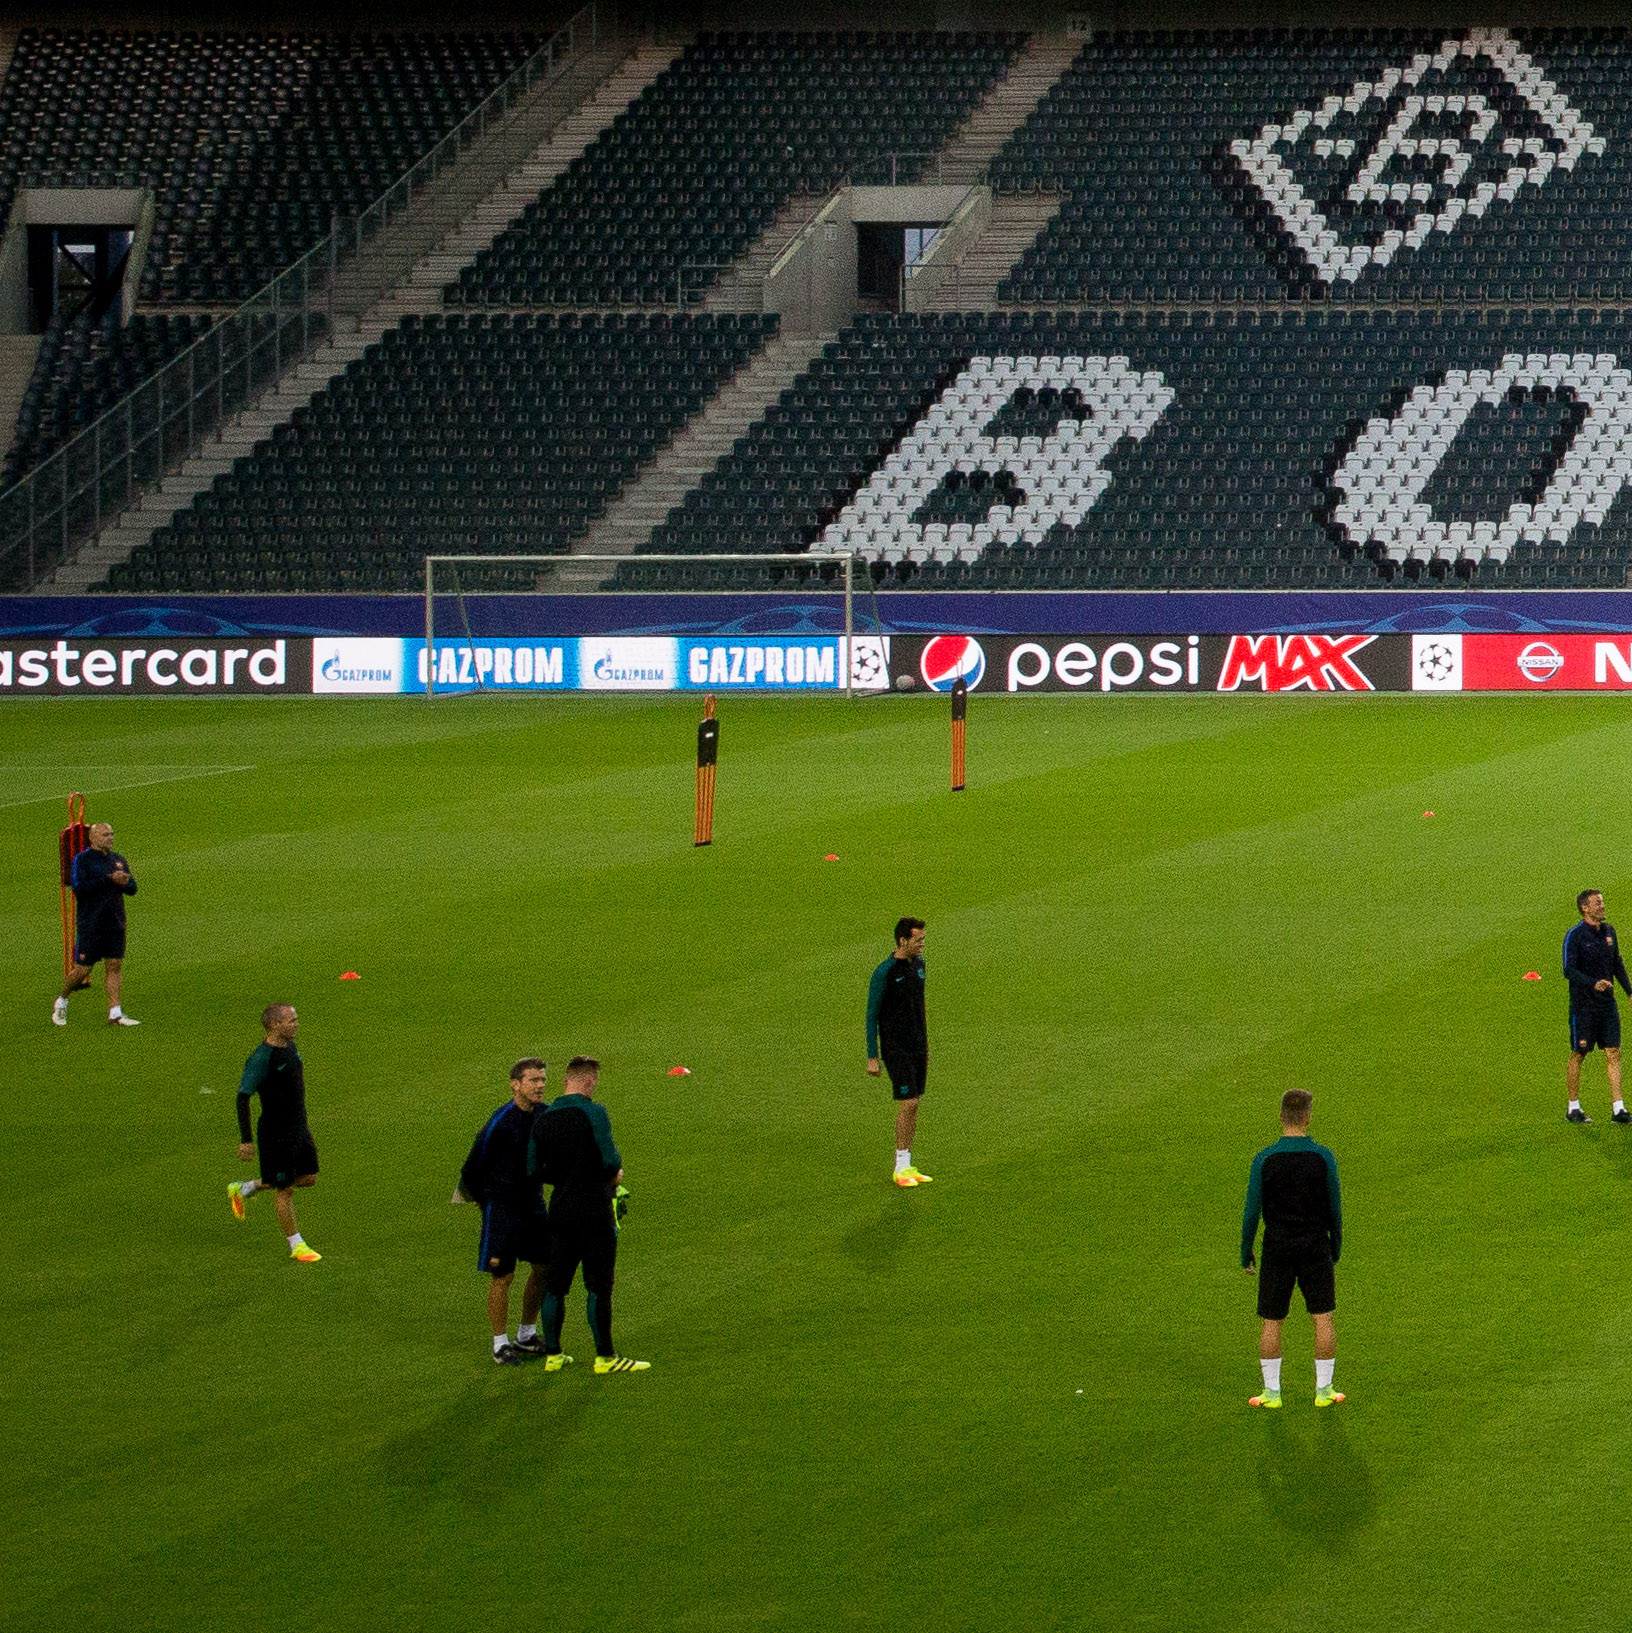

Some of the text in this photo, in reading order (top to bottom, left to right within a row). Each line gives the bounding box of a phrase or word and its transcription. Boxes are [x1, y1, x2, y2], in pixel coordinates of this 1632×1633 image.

[342, 669, 392, 681] GAZPROM
[418, 647, 563, 684] GAZPROM
[614, 669, 663, 681] GAZPROM
[689, 646, 834, 683] GAZPROM
[1007, 635, 1376, 692] pepsi MAX
